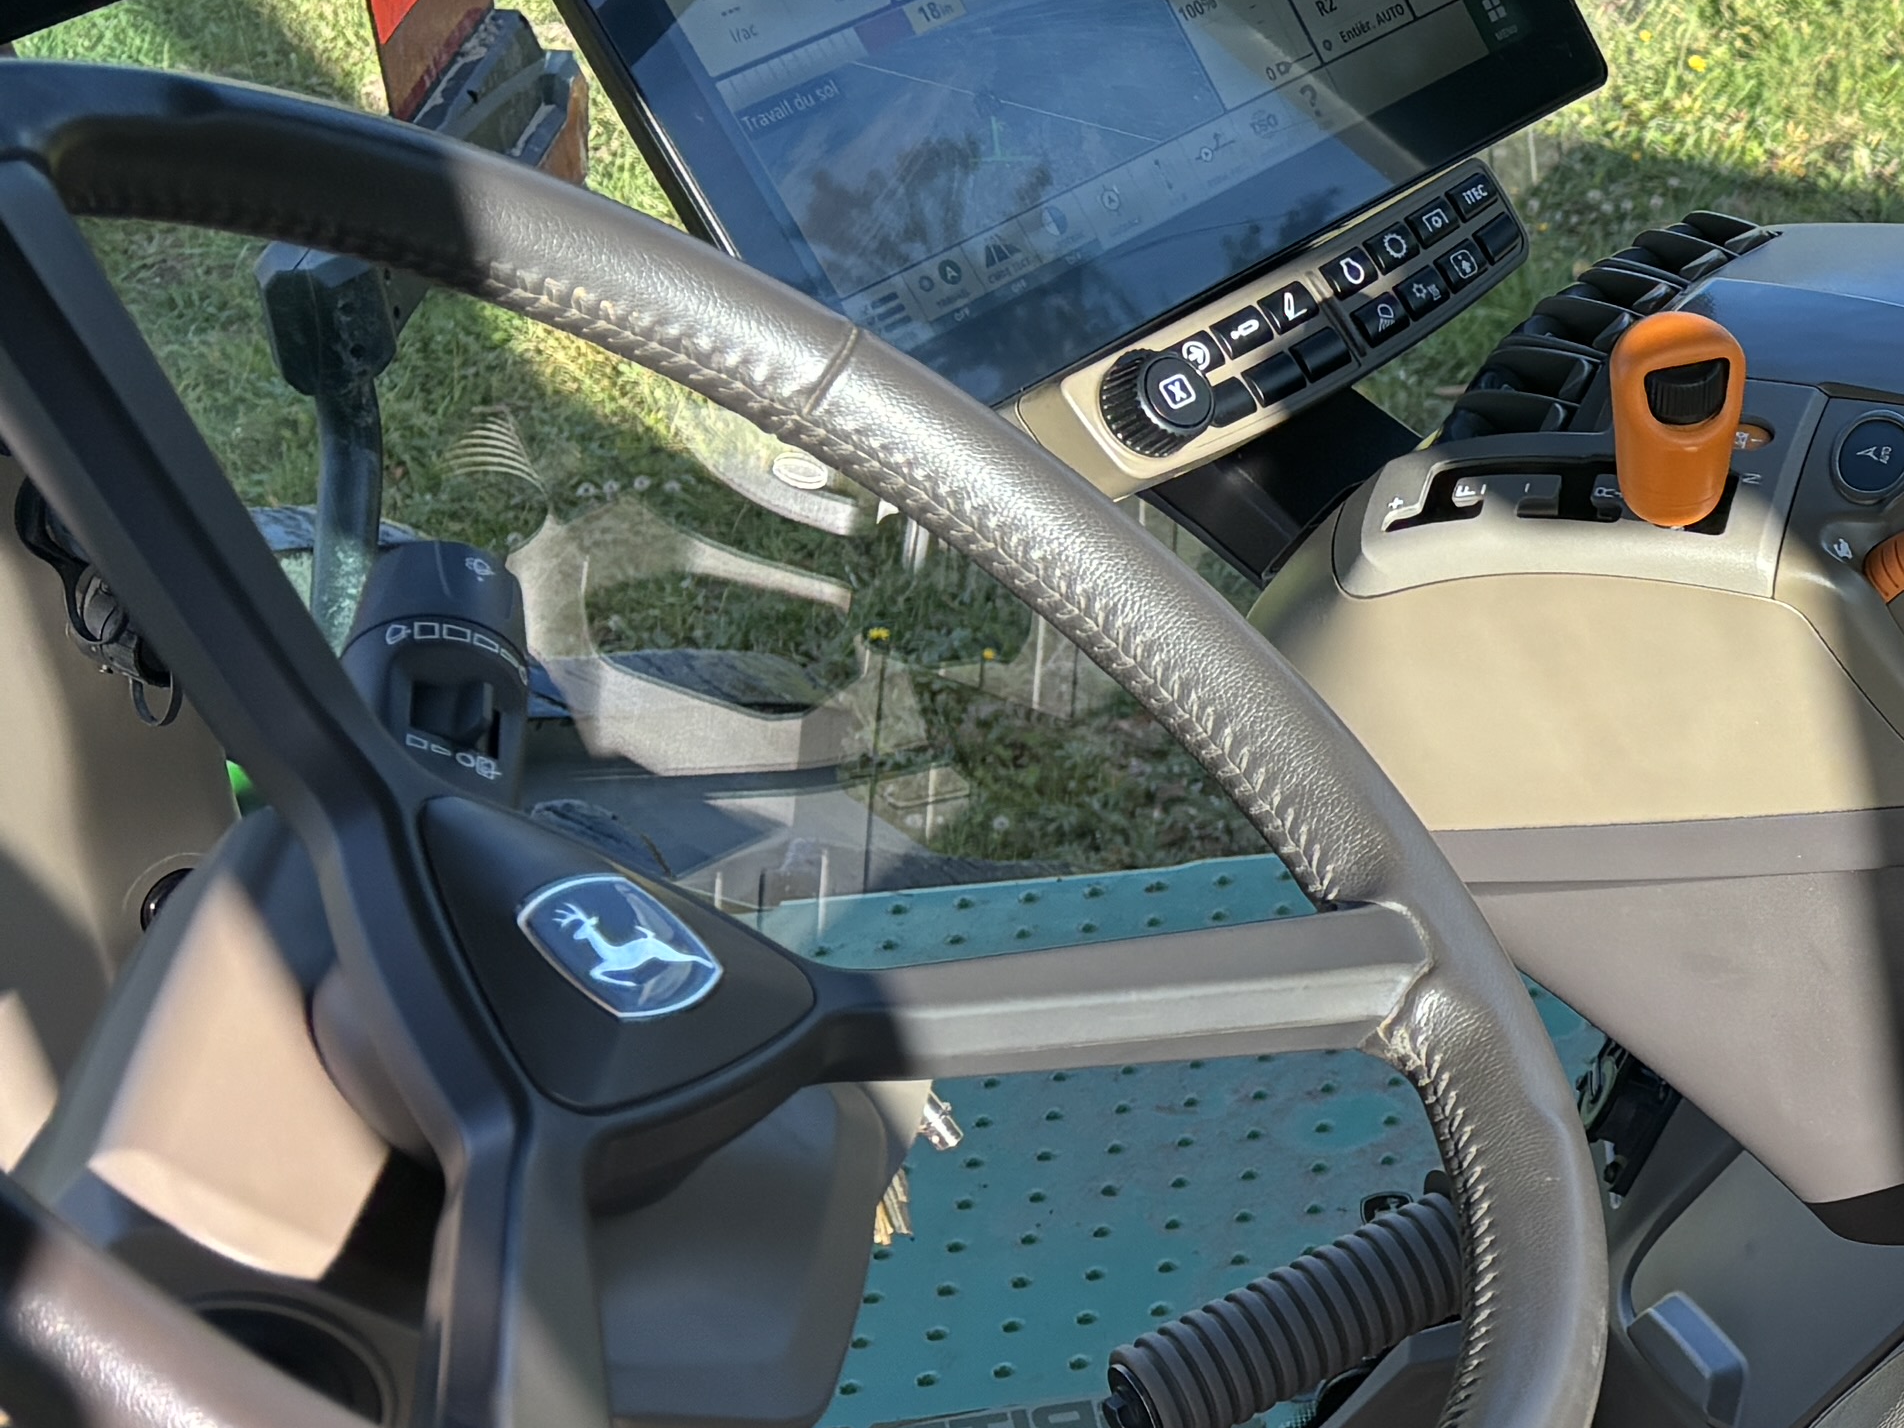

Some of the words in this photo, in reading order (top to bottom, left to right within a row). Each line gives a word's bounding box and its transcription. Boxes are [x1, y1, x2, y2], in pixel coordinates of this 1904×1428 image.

[1376, 3, 1406, 27] AUTO
[729, 24, 759, 43] l/ac
[740, 102, 793, 134] Travail
[792, 92, 816, 113] du
[816, 78, 841, 101] sol
